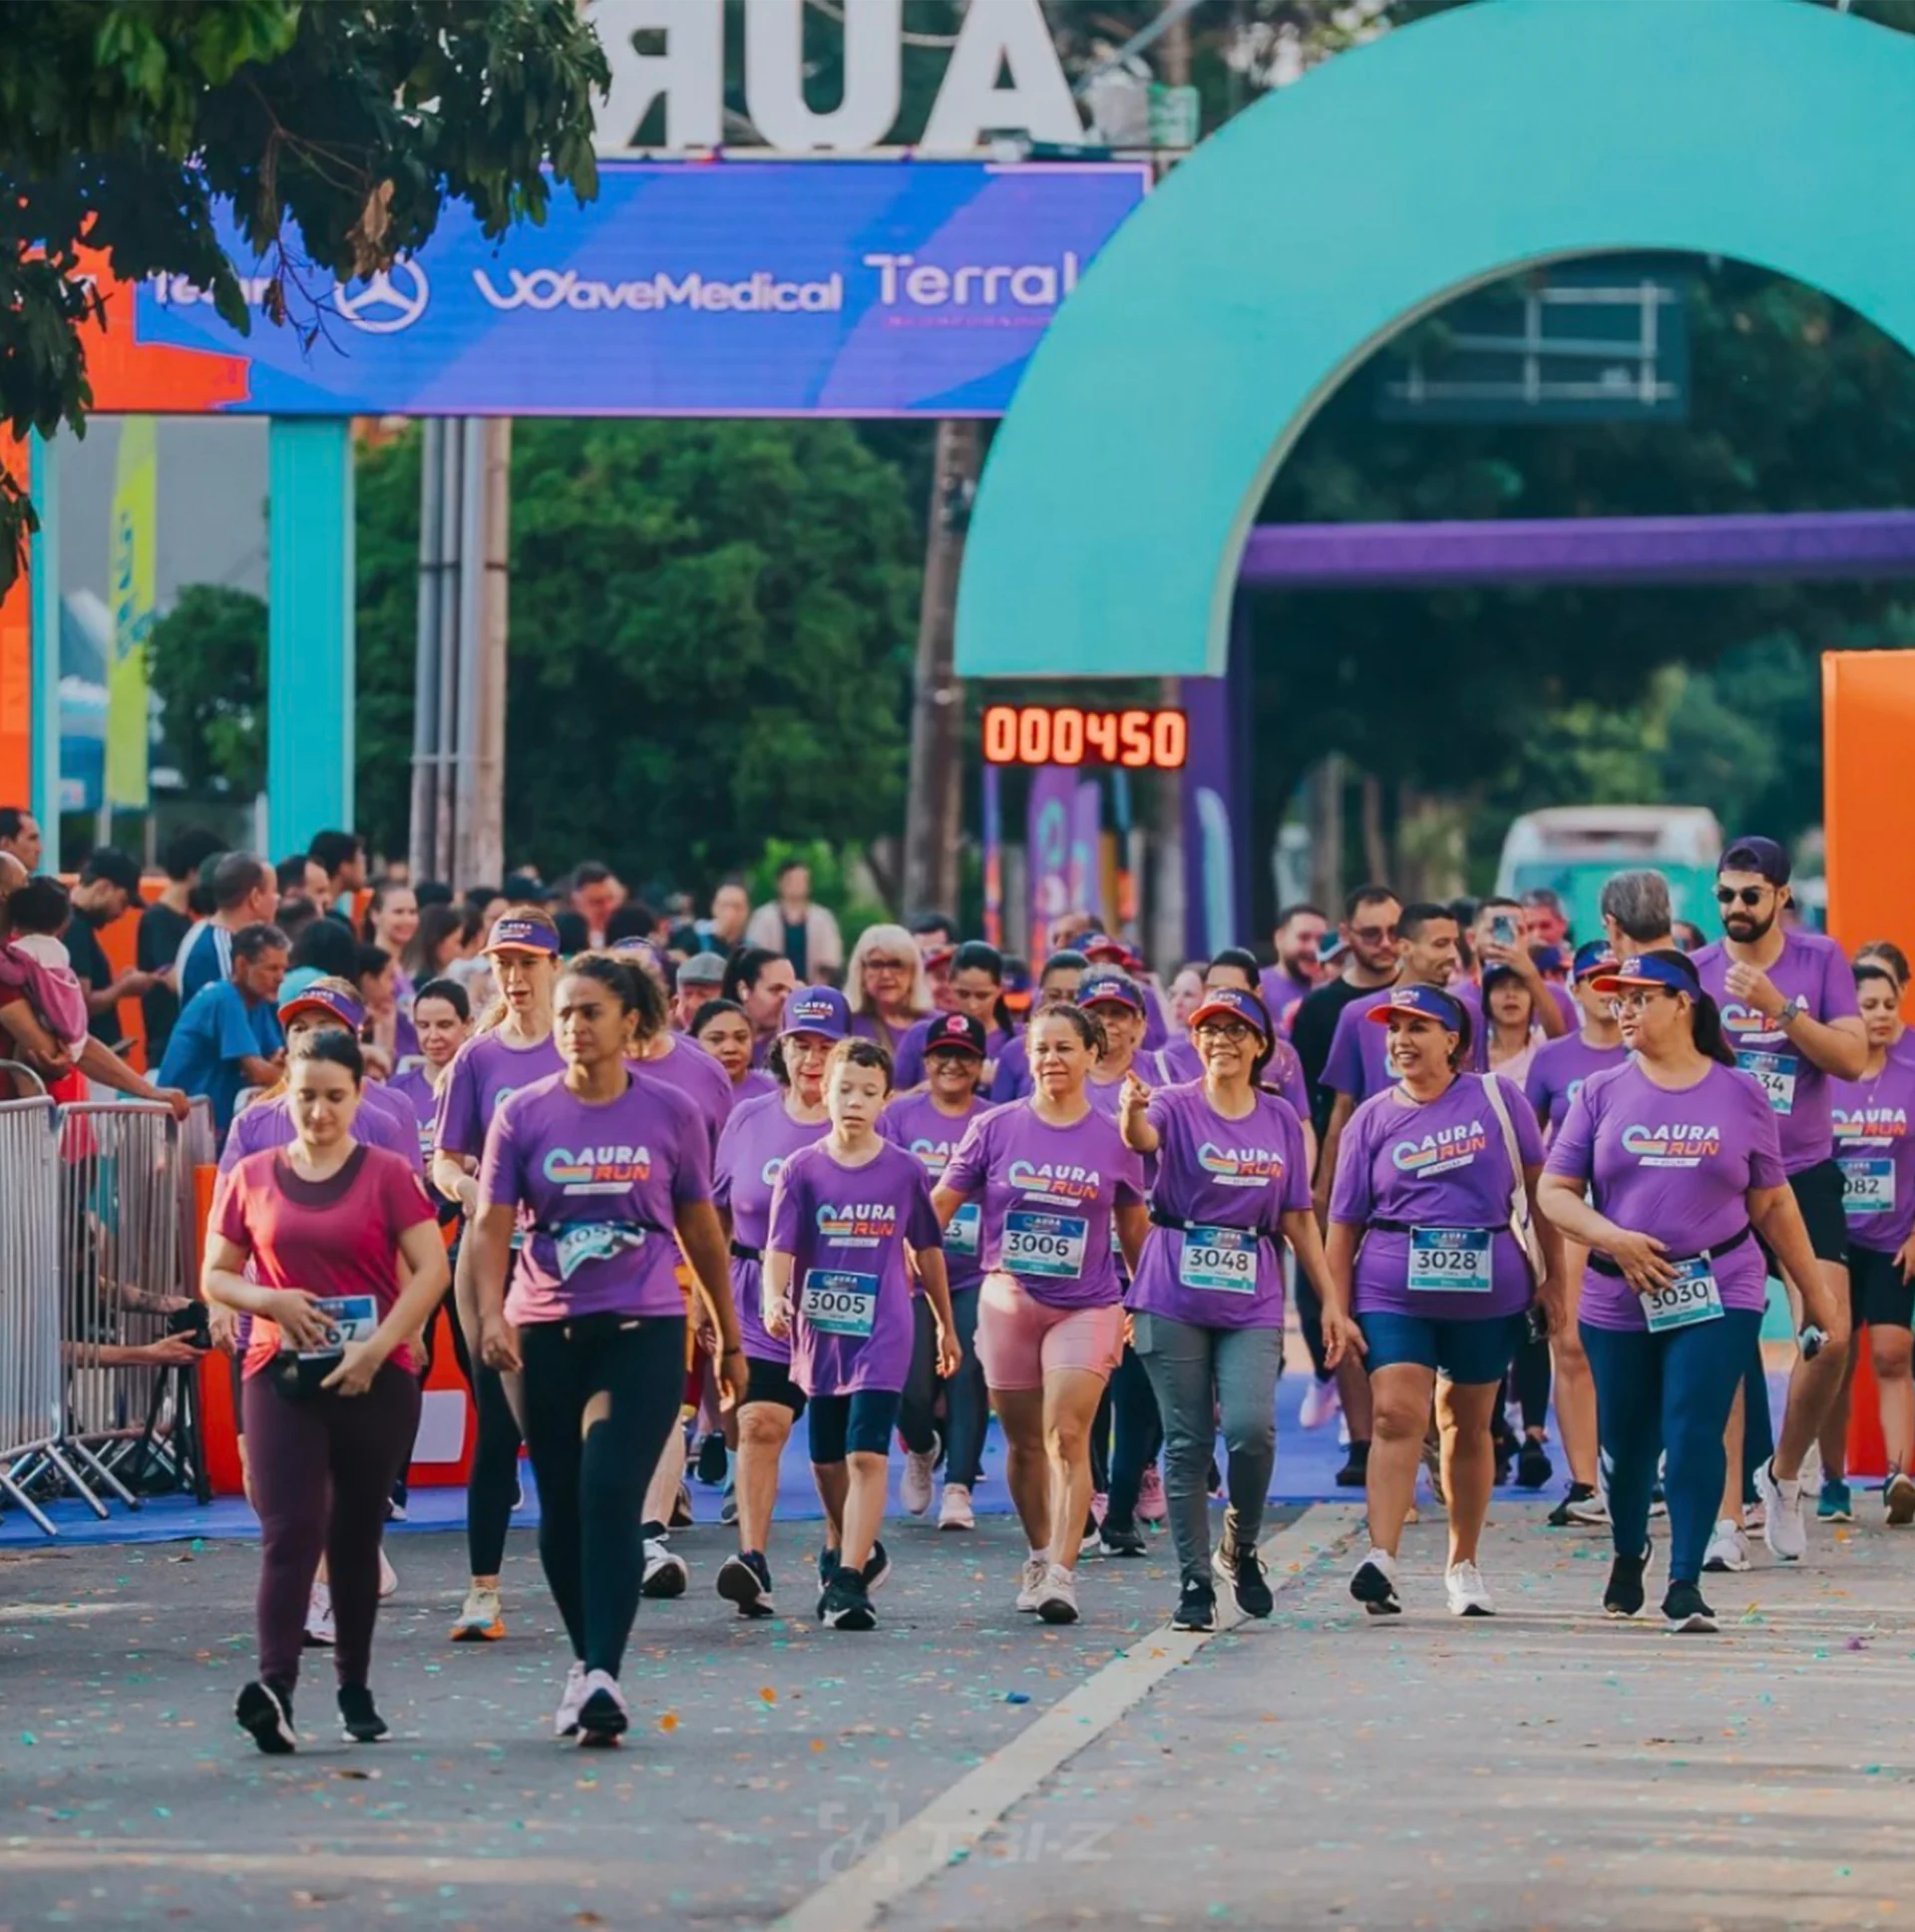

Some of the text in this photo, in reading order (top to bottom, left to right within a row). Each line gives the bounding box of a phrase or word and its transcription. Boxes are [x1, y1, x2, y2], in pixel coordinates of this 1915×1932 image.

[863, 250, 1077, 306] Terral
[472, 267, 843, 311] WaveMedical
[983, 706, 1187, 768] 000450
[1748, 1071, 1785, 1092] 34
[1850, 1107, 1907, 1124] AURA
[1420, 1120, 1485, 1150] AURA
[1653, 1124, 1721, 1140] AURA
[575, 1146, 651, 1166] AURA
[1225, 1148, 1284, 1164] AURA
[1438, 1136, 1486, 1161] RUN
[1667, 1141, 1720, 1155] RUN
[593, 1165, 650, 1181] RUN
[1037, 1164, 1100, 1186] AURA
[1049, 1180, 1099, 1200] RUN
[839, 1204, 896, 1220] AURA
[853, 1221, 895, 1236] RUN
[1008, 1232, 1069, 1257] 3006
[1189, 1249, 1250, 1272] 3048
[1417, 1251, 1478, 1270] 3028
[808, 1292, 866, 1315] 3005
[1652, 1281, 1709, 1310] 3030
